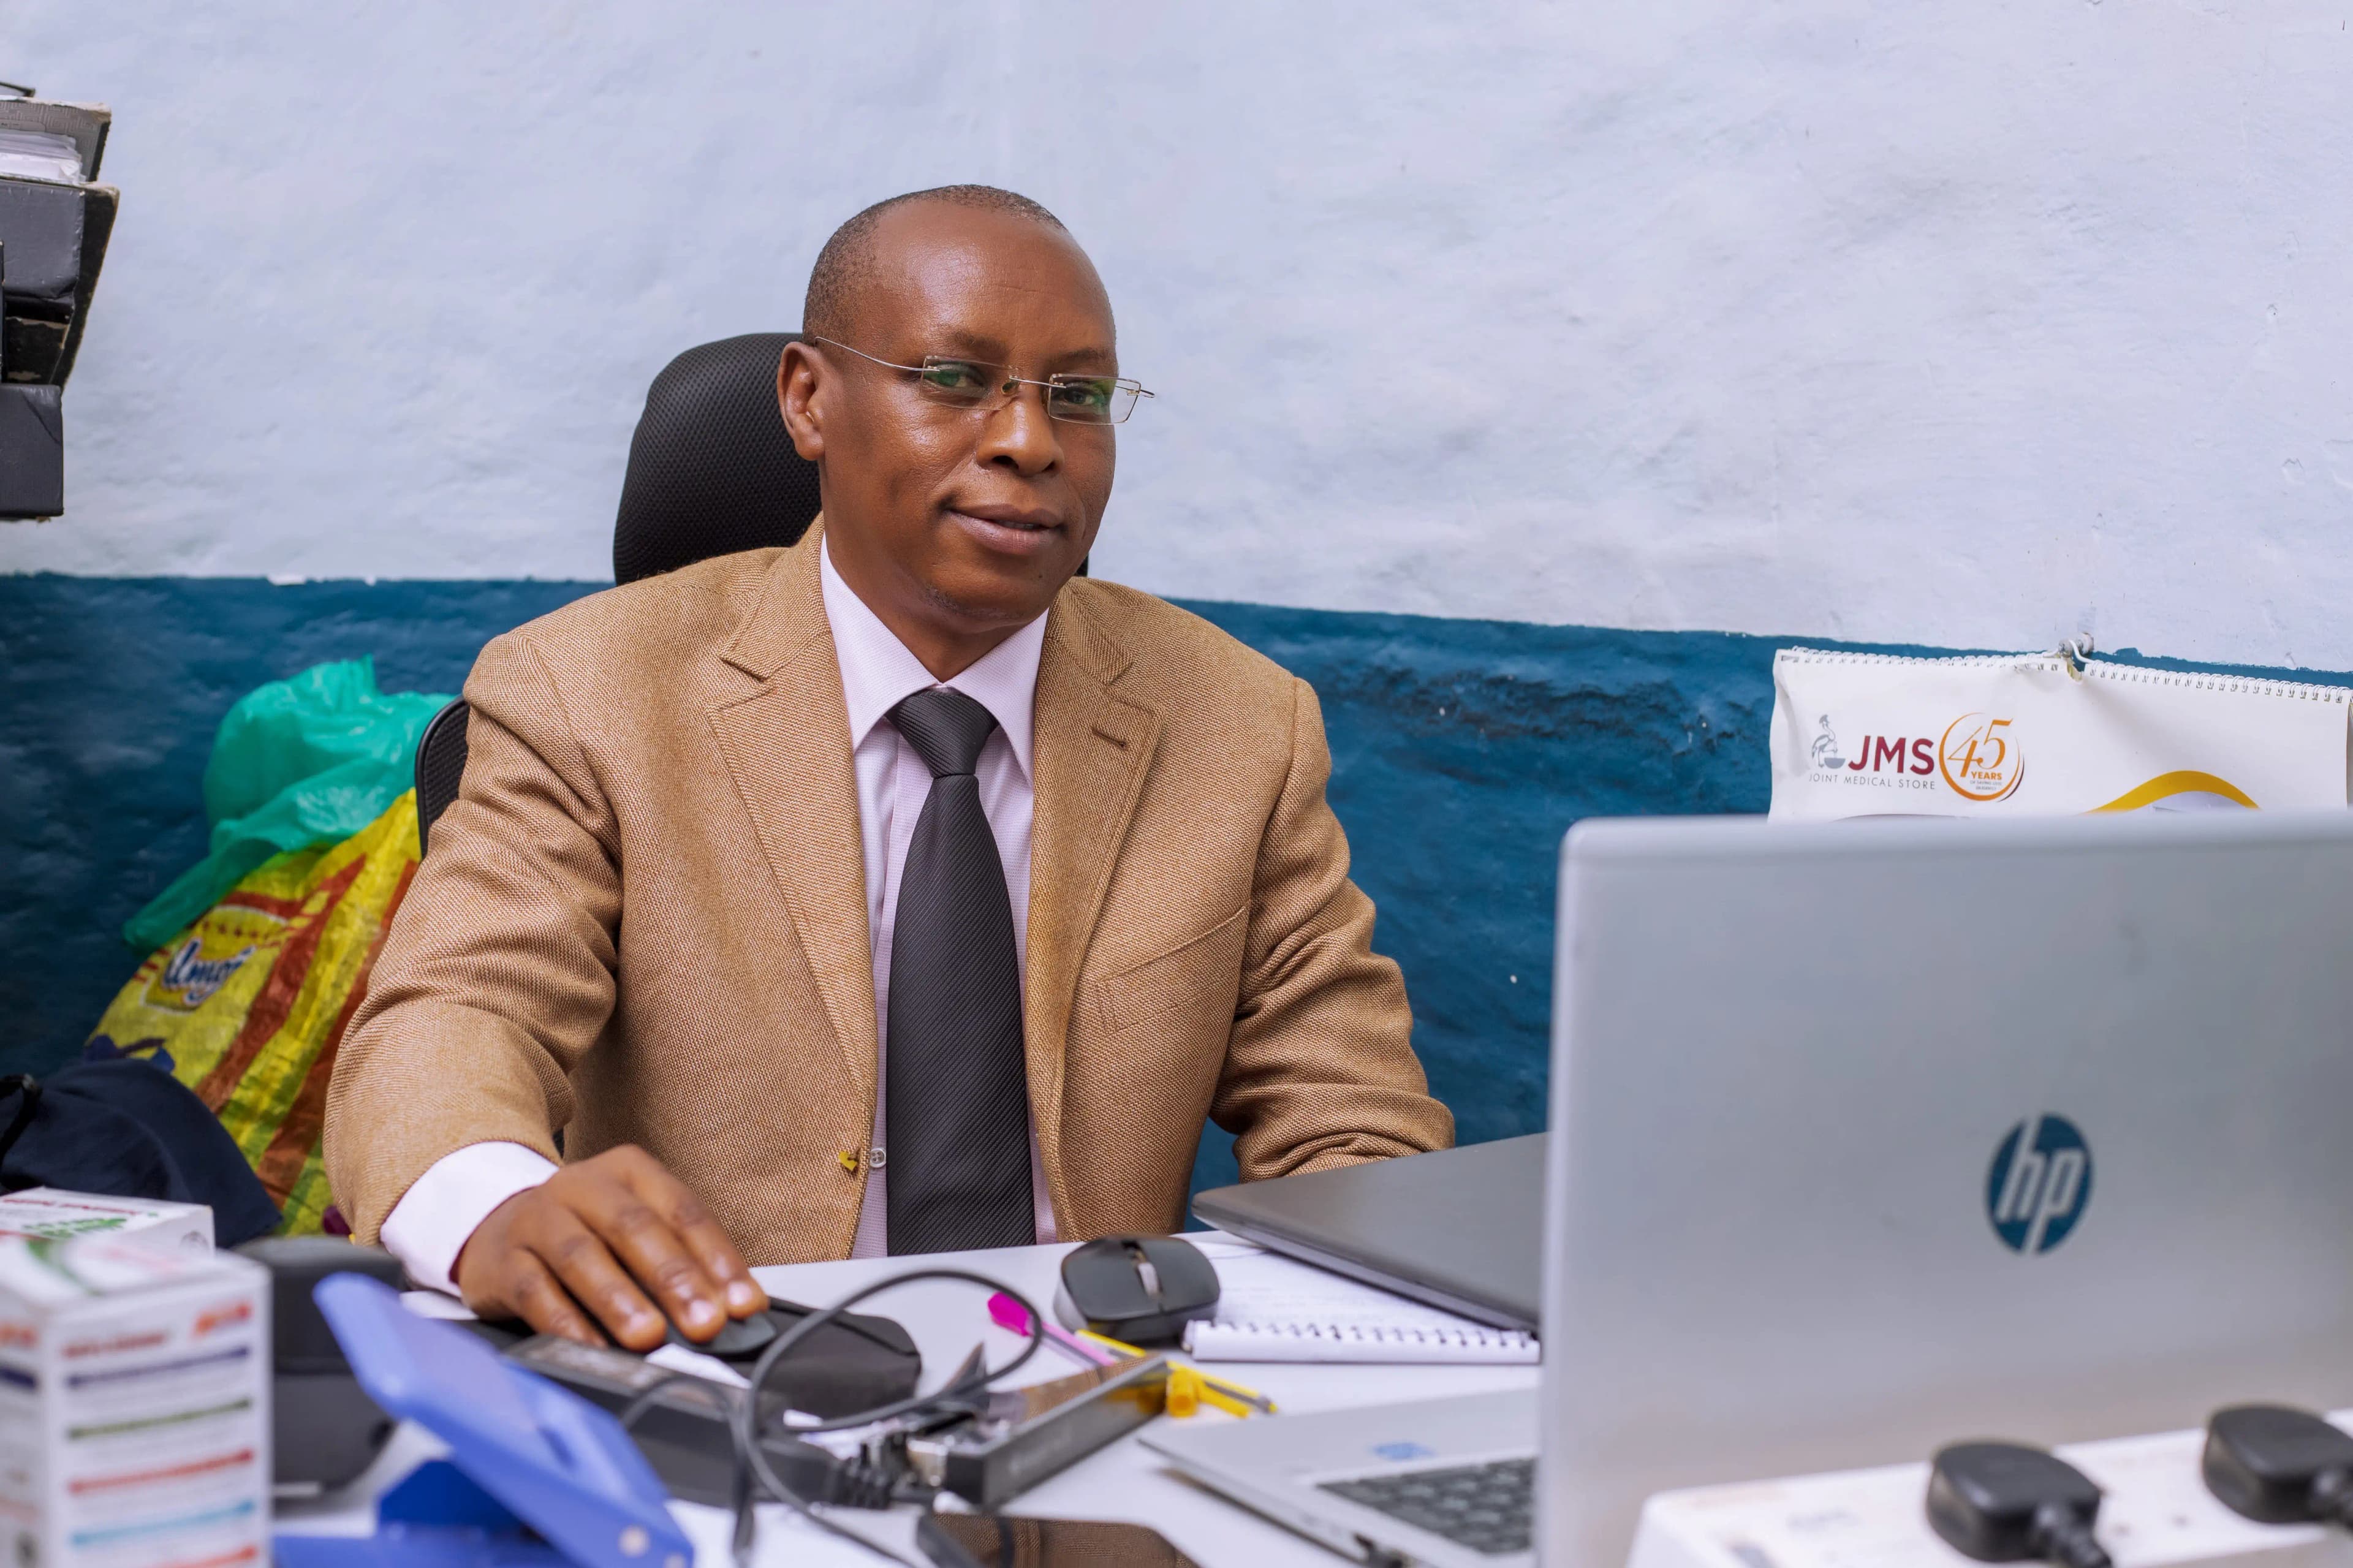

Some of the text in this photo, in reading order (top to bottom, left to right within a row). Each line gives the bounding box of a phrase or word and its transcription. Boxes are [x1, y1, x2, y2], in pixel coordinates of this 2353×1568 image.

[1847, 735, 1934, 775] JMS
[1947, 718, 2013, 778] 45
[1809, 773, 1935, 790] JOINT MEDICAL STORE
[1971, 771, 2002, 780] YEARS
[1993, 1115, 2085, 1256] hp
